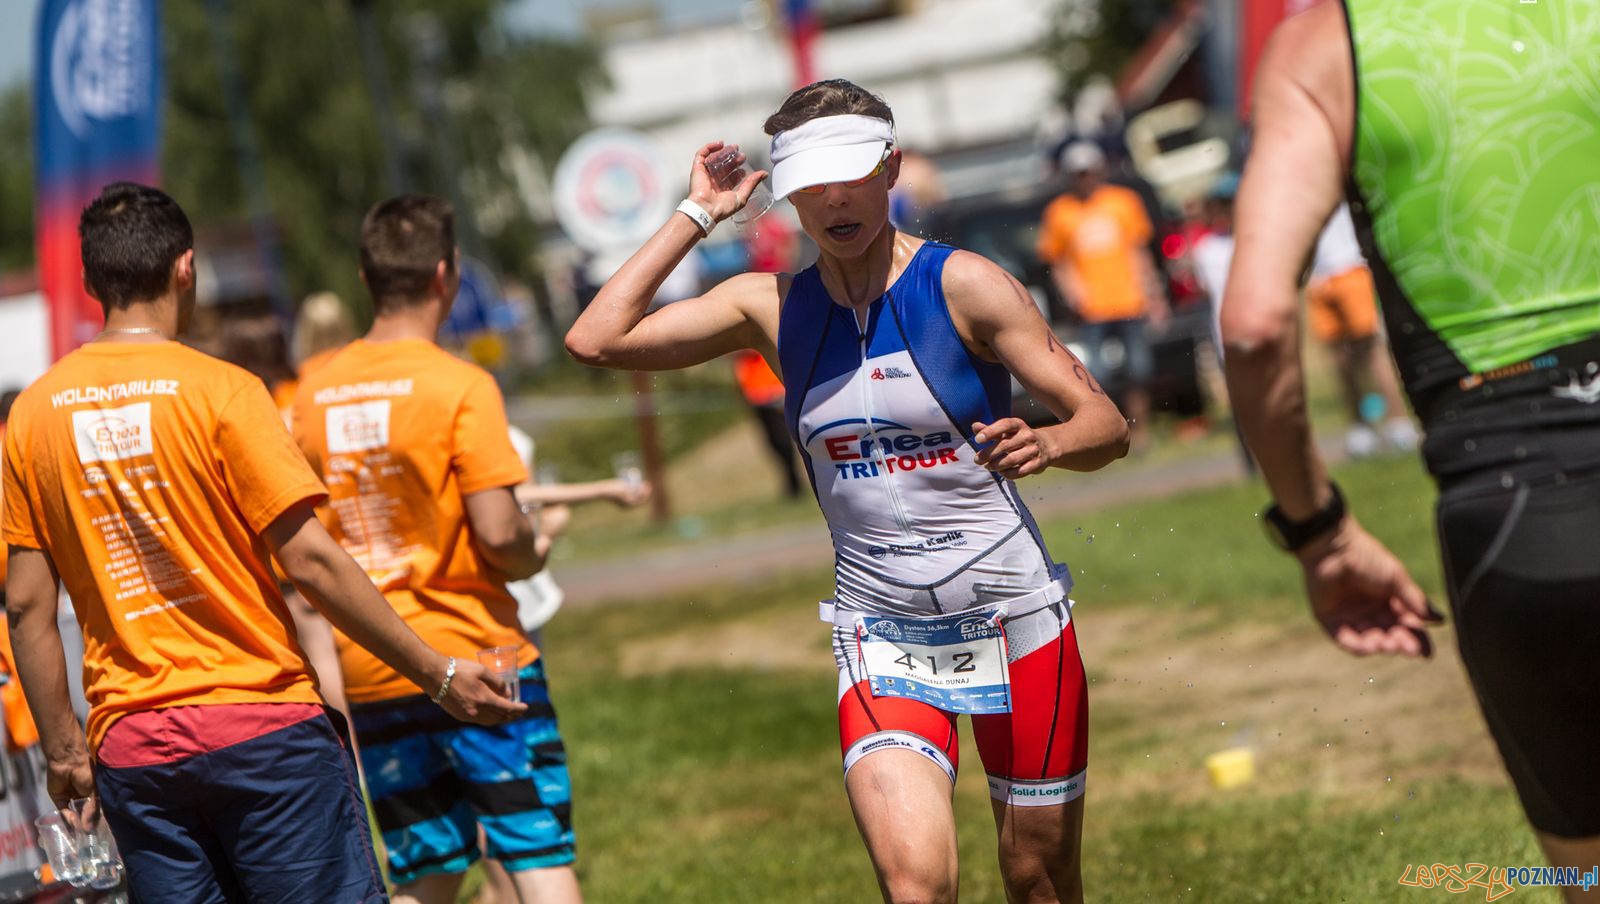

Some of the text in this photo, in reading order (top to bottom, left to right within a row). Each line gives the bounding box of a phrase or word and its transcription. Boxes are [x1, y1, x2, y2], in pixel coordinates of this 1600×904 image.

[51, 379, 180, 409] WOLONTARIUSZ
[825, 431, 953, 461] Enea
[836, 447, 960, 480] TRITOUR
[925, 530, 965, 547] Karlik
[961, 629, 1001, 640] TRITOUR
[894, 651, 976, 676] 412
[945, 677, 970, 685] DUNAJ
[1011, 787, 1036, 797] Solid
